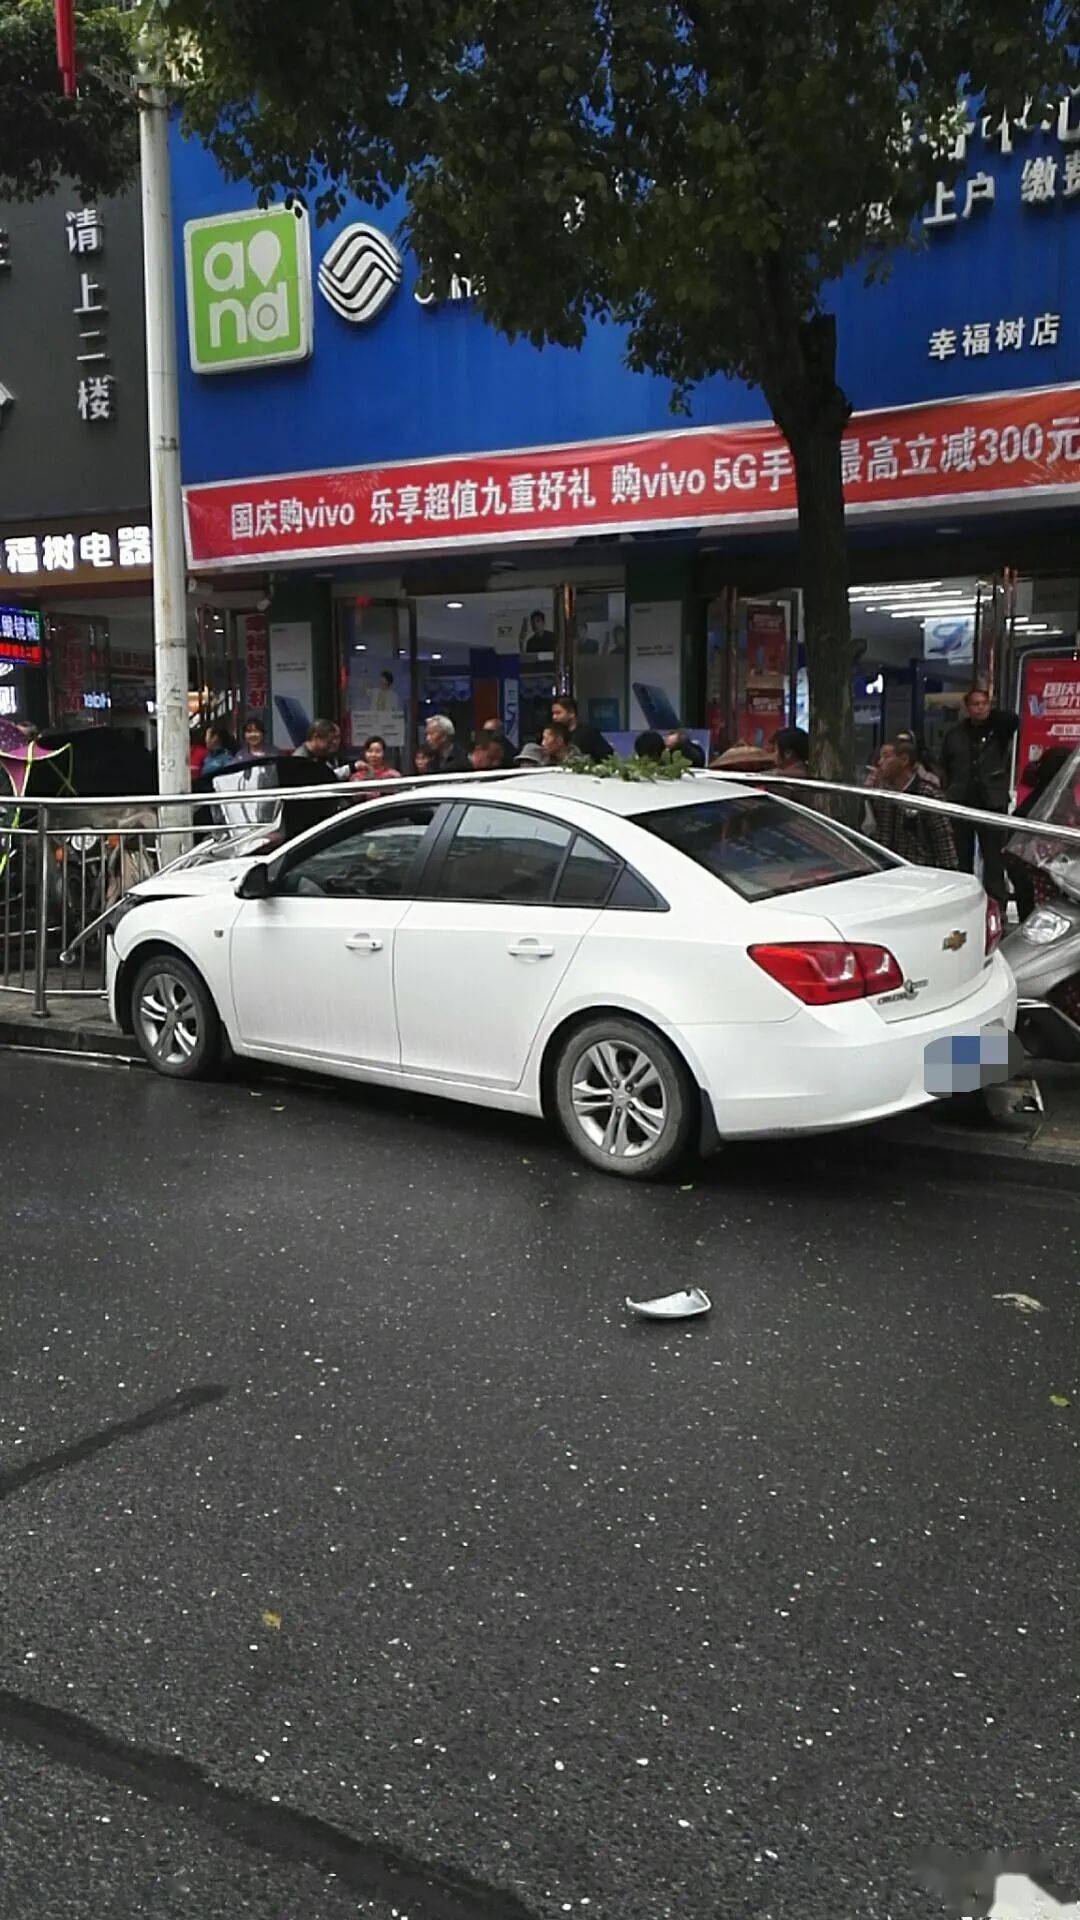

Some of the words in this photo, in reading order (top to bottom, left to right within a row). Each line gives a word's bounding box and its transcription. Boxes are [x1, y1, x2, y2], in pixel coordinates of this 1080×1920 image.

[922, 171, 996, 225] 上户
[65, 207, 113, 421] 请上二楼
[927, 313, 1062, 361] 幸福树店
[231, 495, 355, 541] 国庆购vivo
[370, 465, 597, 528] 乐享超值九重好礼
[0, 525, 152, 574] 福树电器
[1042, 681, 1080, 698] 国庆
